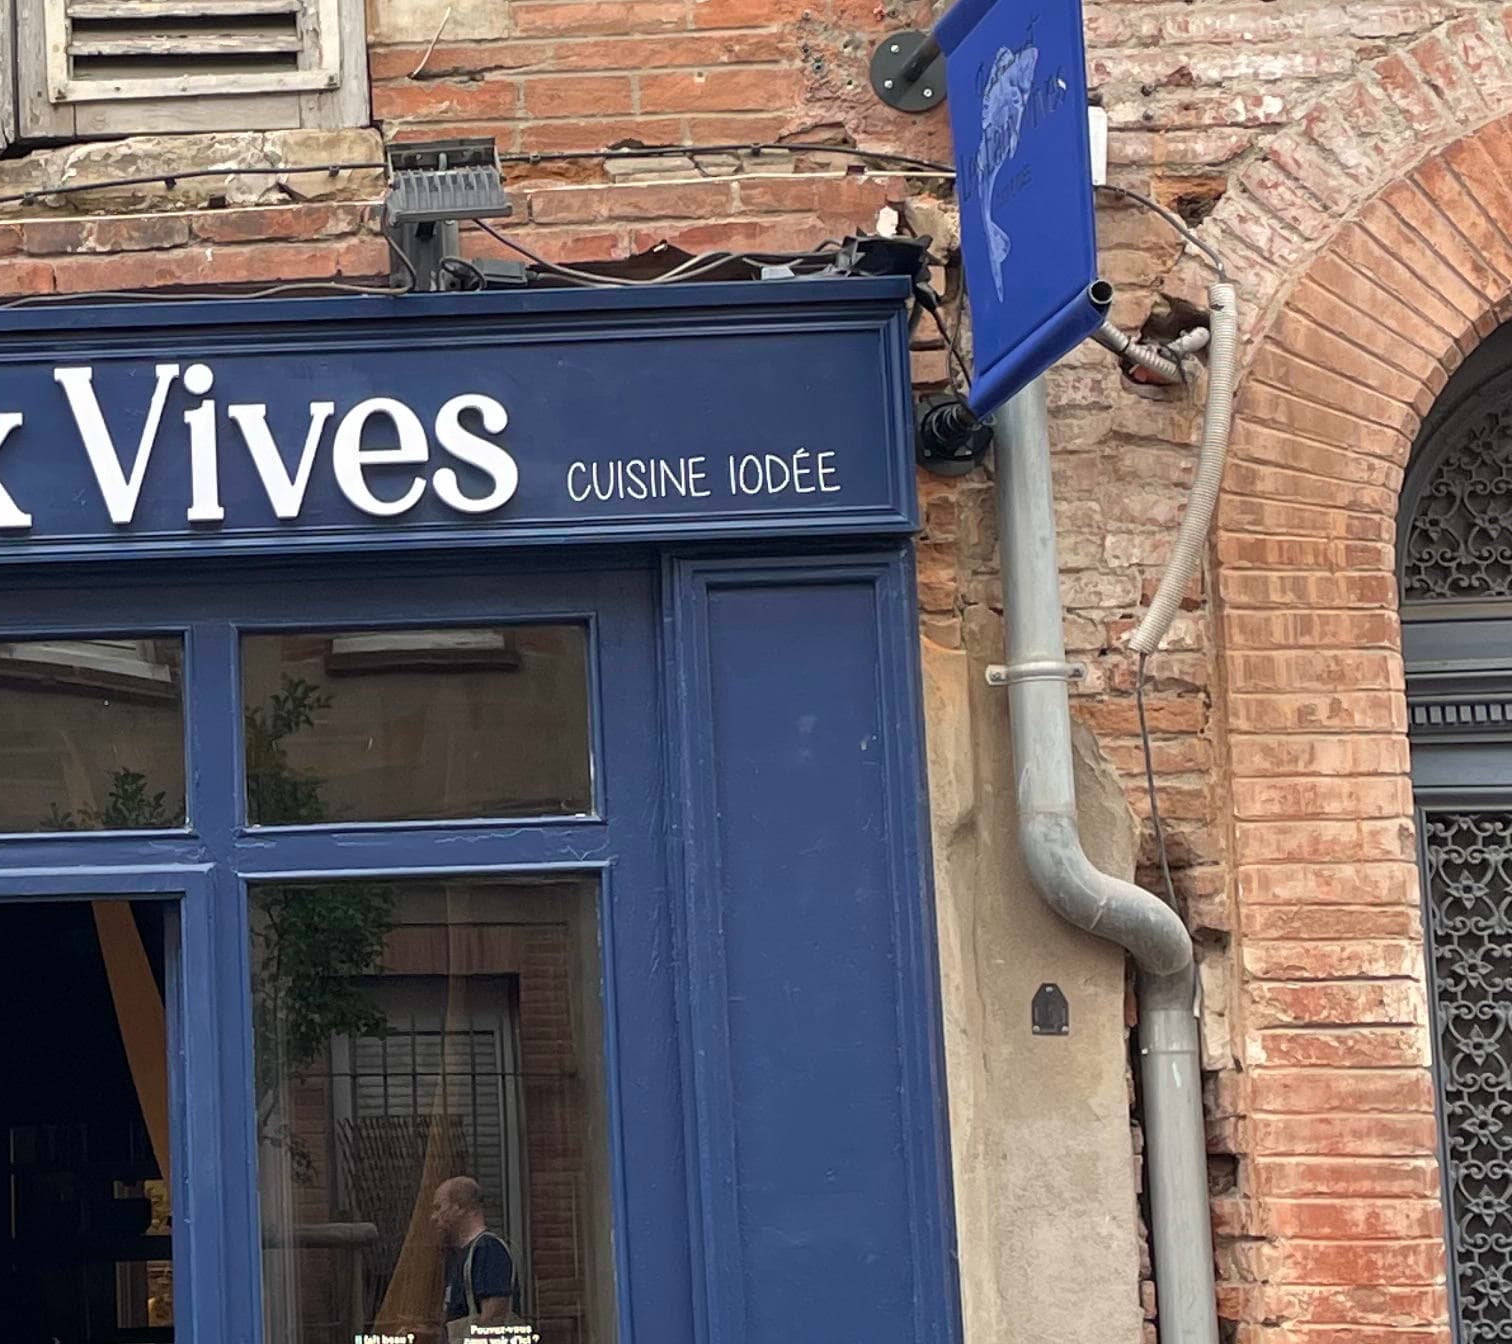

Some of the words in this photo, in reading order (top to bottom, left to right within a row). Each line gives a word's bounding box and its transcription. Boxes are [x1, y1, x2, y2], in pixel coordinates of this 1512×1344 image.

[53, 363, 519, 525] Vives
[567, 456, 711, 502] CUISINE
[729, 447, 841, 495] IODÉE
